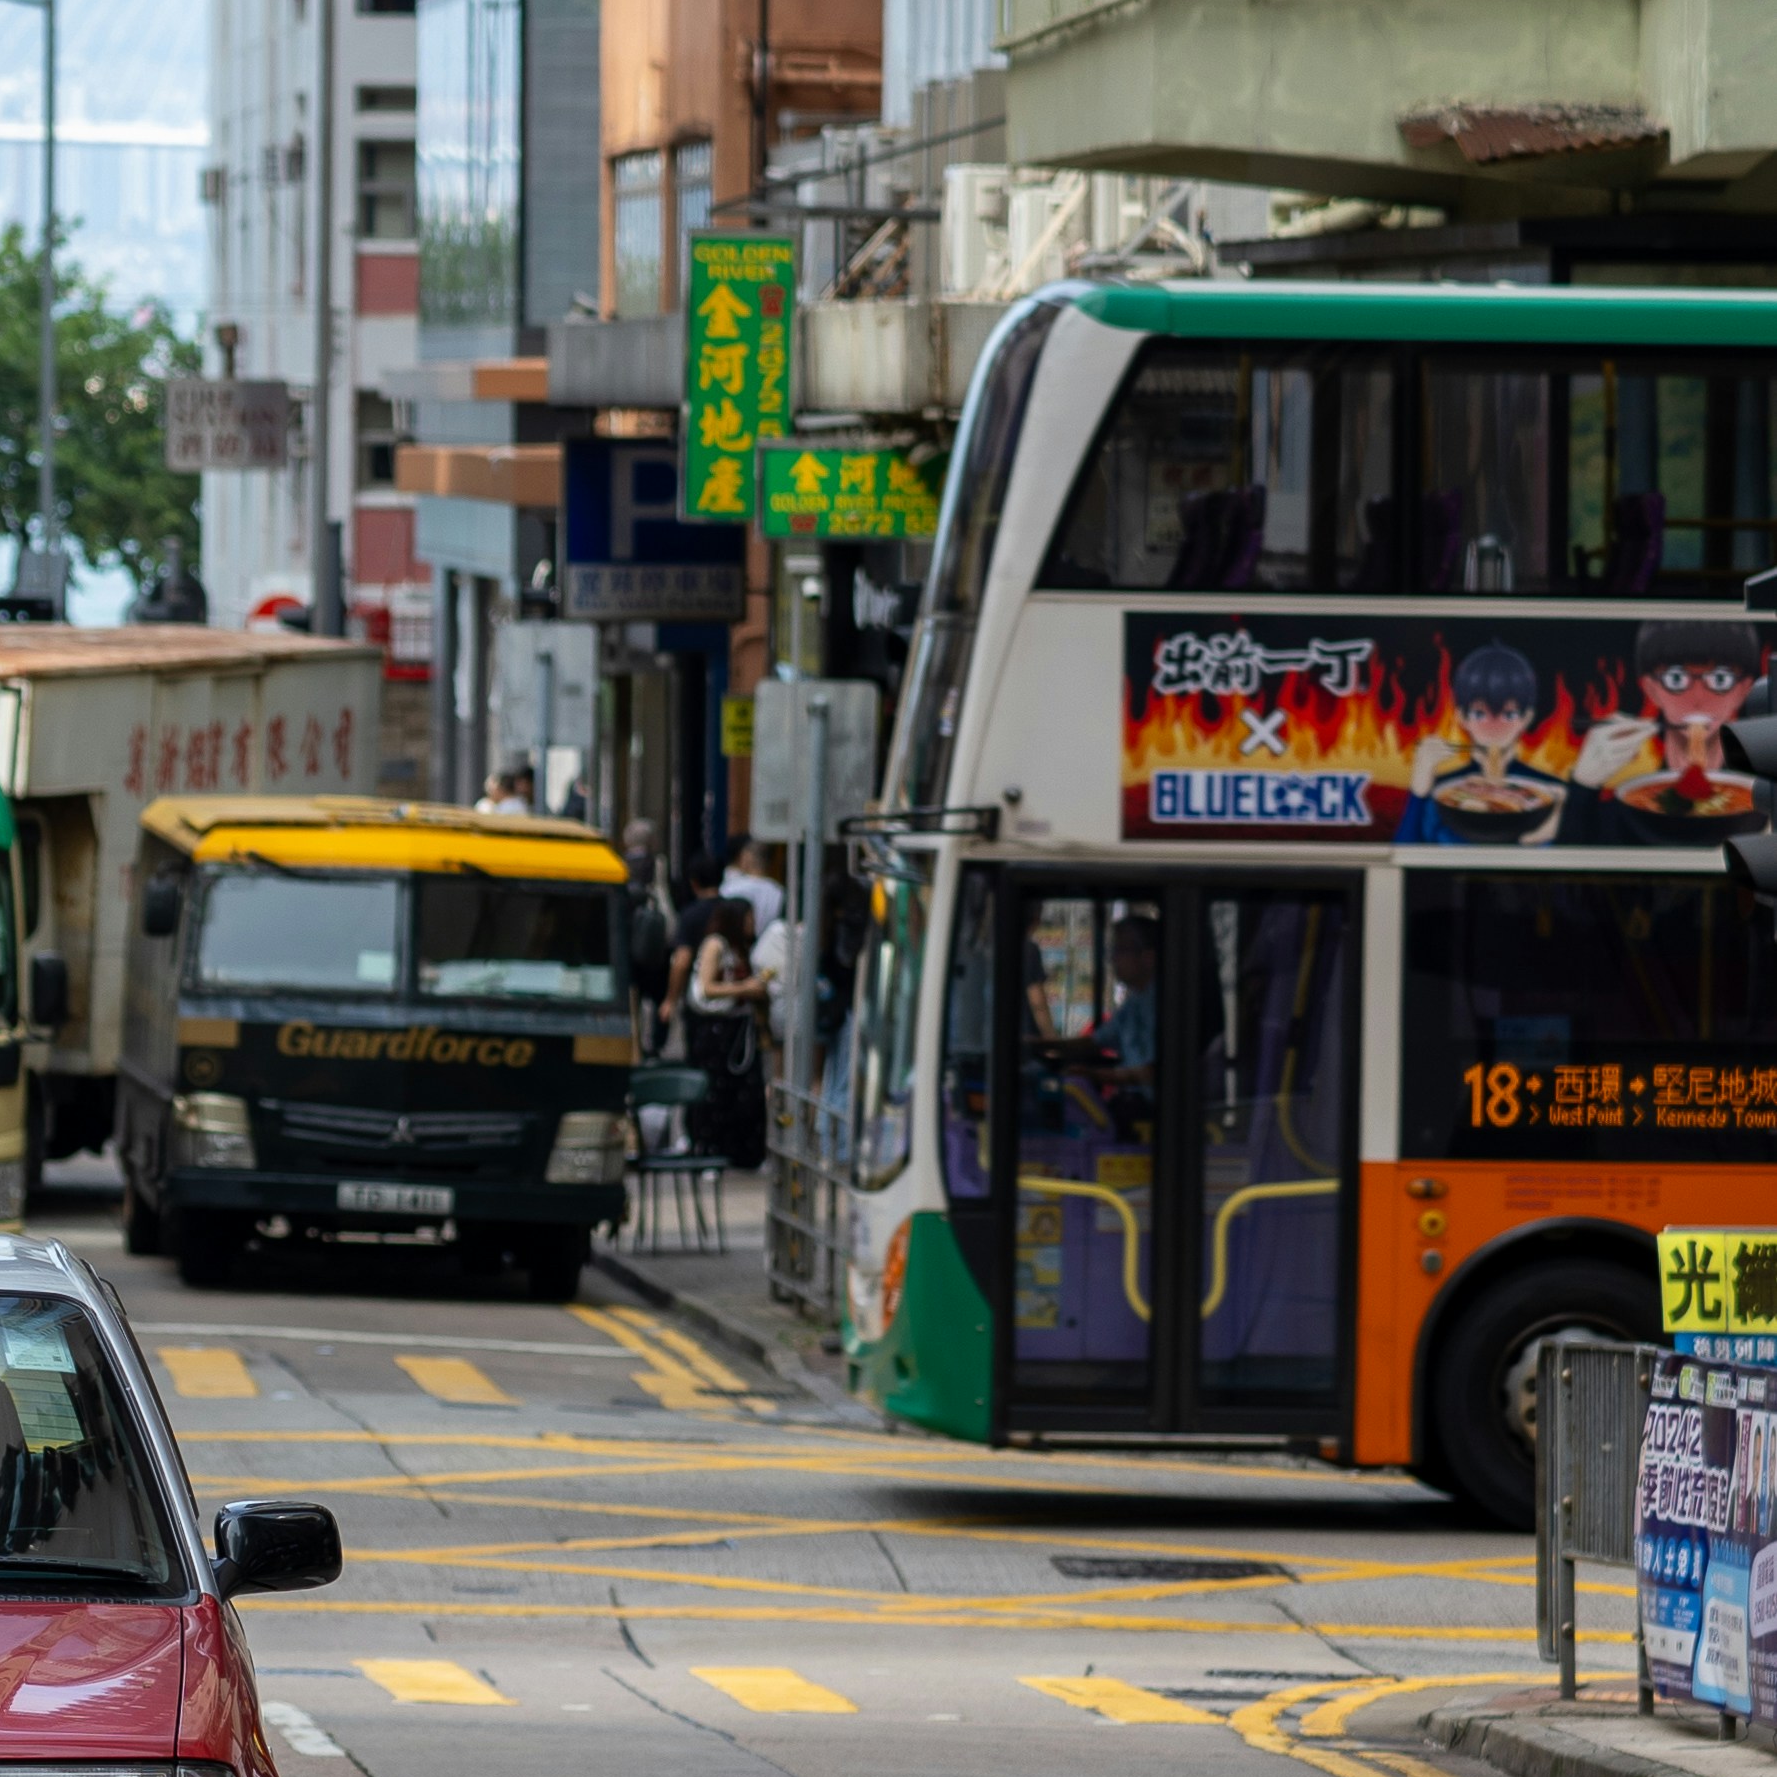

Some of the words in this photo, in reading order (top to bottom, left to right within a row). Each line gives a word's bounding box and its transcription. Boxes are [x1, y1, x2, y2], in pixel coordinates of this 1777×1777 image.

[694, 244, 793, 264] GOLDEN
[707, 263, 776, 282] RIVER
[697, 283, 754, 514] 金河地產
[771, 493, 829, 513] GOLDEN
[834, 493, 877, 513] RIVER
[1153, 630, 1373, 697] 出前一丁
[277, 1019, 536, 1068] Guardforce
[1464, 1062, 1520, 1128] 18
[1554, 1064, 1621, 1104] 西環
[1653, 1063, 1777, 1106] 堅尼地城
[1549, 1106, 1584, 1127] West
[1587, 1106, 1623, 1127] Point
[1656, 1106, 1727, 1129] Kennedy
[1666, 1241, 1777, 1326] 光纖
